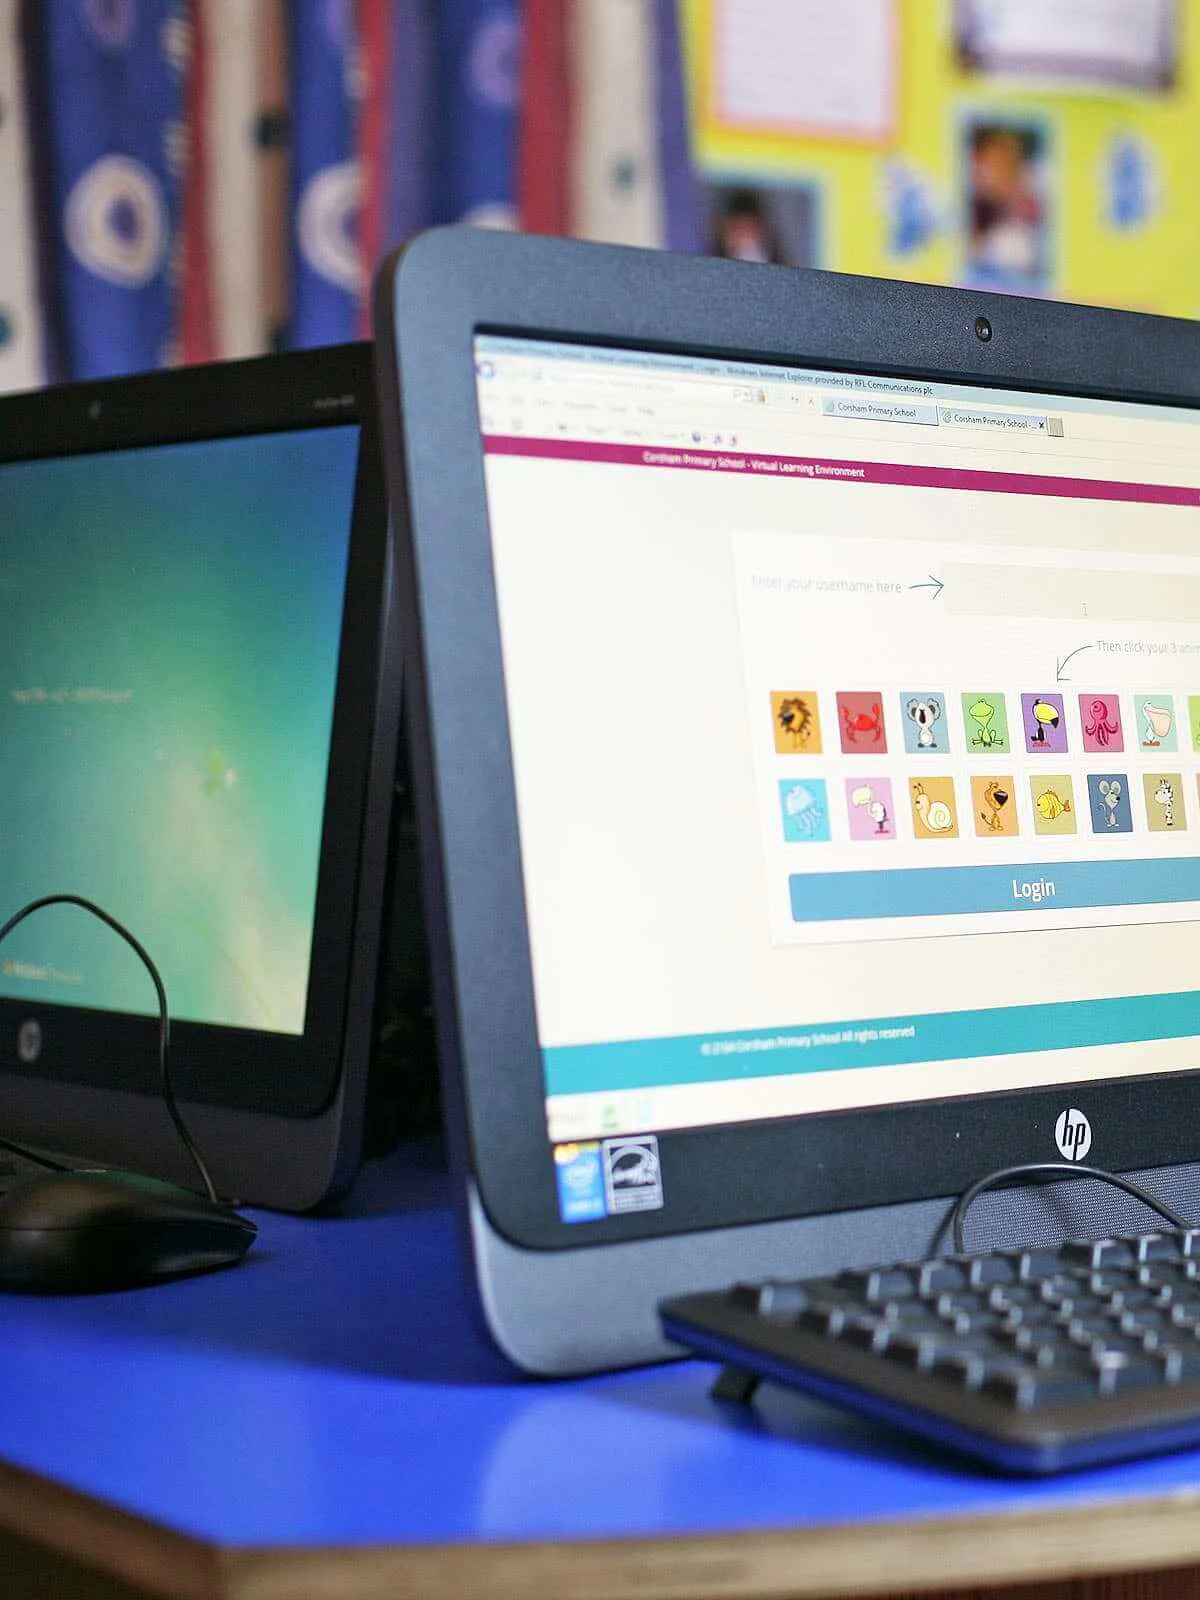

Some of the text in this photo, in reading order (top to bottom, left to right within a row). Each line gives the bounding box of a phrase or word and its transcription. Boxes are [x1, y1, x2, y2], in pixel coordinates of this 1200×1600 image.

[787, 371, 813, 384] Explorer
[815, 375, 844, 386] provided
[845, 378, 854, 388] by
[867, 379, 922, 394] Communications
[923, 384, 934, 395] plc
[838, 402, 917, 418] Corsham Primary School
[954, 414, 982, 425] Corsham
[982, 416, 1006, 429] Primary
[1006, 419, 1028, 430] School
[683, 454, 717, 470] Primary
[718, 456, 746, 469] School
[751, 459, 778, 472] Virtual
[779, 461, 815, 476] Learning
[815, 464, 865, 478] Environment
[787, 576, 813, 594] your
[816, 576, 874, 593] username
[876, 579, 903, 594] here
[1097, 640, 1122, 652] Then
[1124, 640, 1145, 653] click
[1146, 642, 1169, 656] your
[1171, 642, 1178, 654] 3
[1012, 878, 1057, 903] Login
[776, 1035, 811, 1050] Primary
[812, 1032, 841, 1046] School
[854, 1029, 878, 1044] rights
[878, 1025, 916, 1039] reserved
[1058, 1108, 1089, 1161] hp
